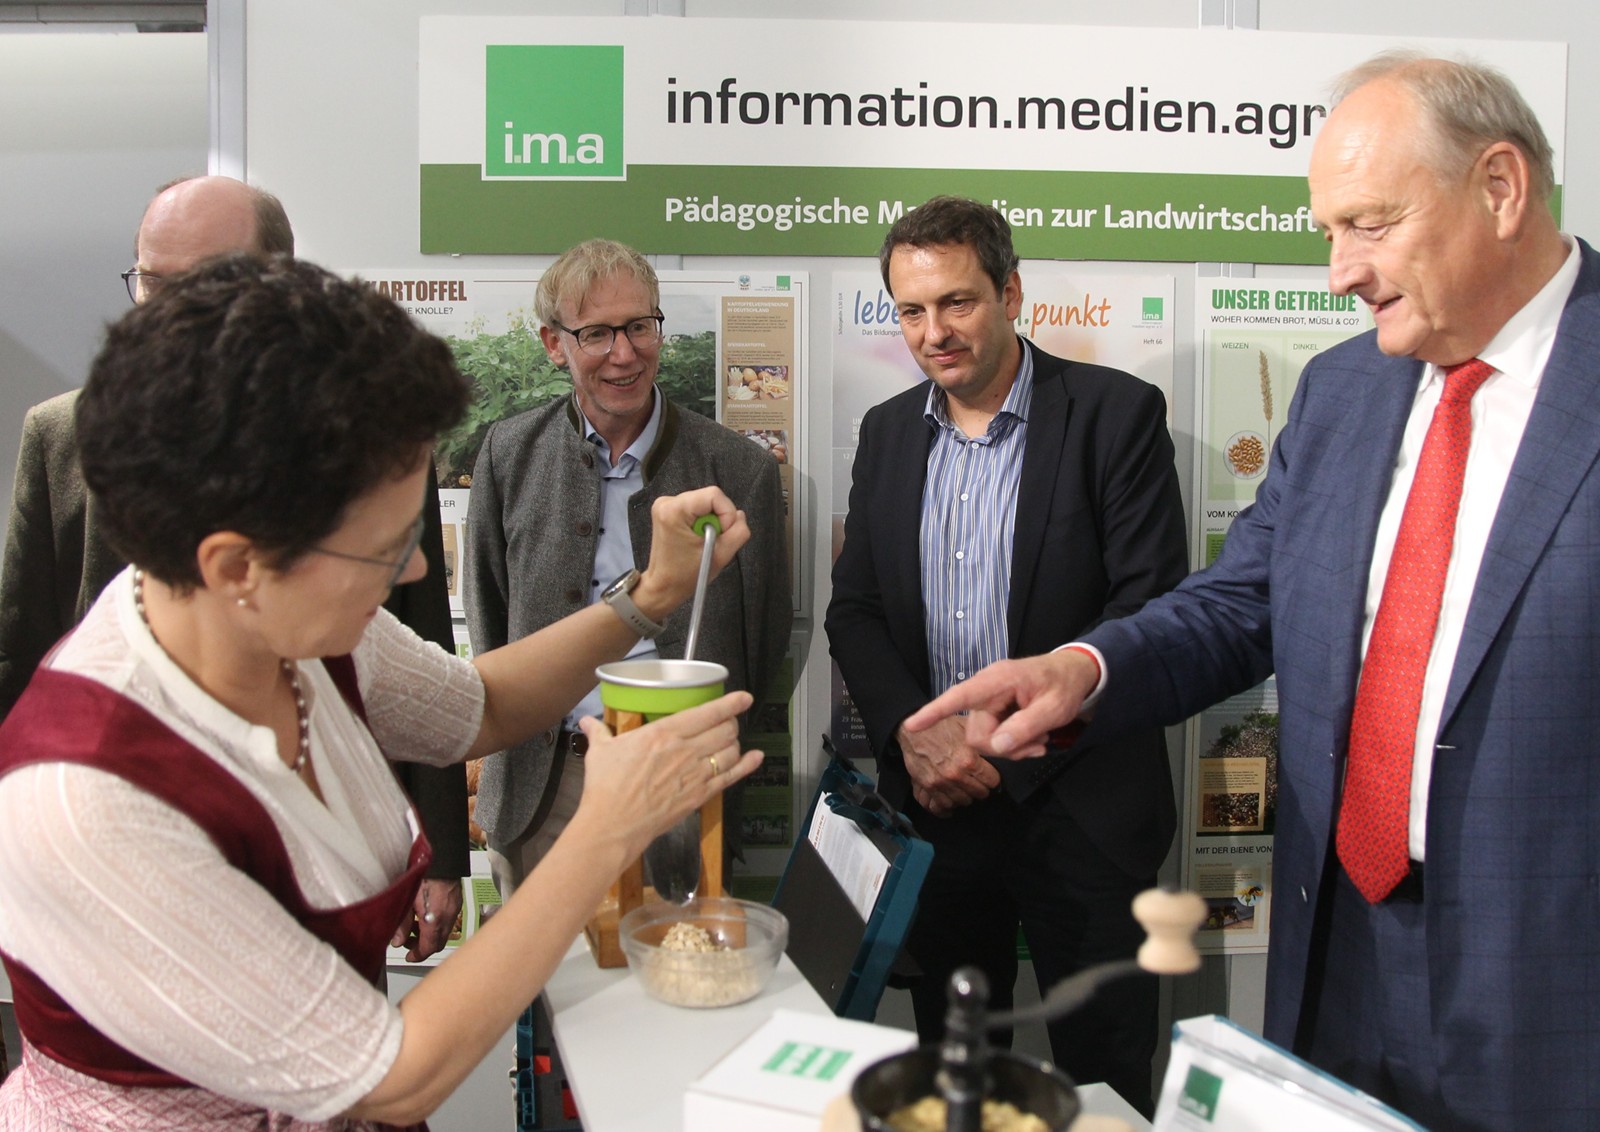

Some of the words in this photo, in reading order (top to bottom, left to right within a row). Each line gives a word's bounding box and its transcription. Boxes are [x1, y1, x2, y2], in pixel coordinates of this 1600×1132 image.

[667, 77, 1327, 149] information.medien.agr
[505, 121, 604, 164] i.m.a
[665, 196, 869, 232] Pädagogische
[1051, 207, 1097, 229] zur
[1104, 203, 1319, 233] Landwirtschaft
[1211, 289, 1270, 311] UNSER
[1274, 290, 1357, 312] GETREIDE
[415, 307, 454, 315] KNOLLE?
[854, 288, 900, 325] lebe
[1211, 316, 1242, 324] WOHER
[1244, 316, 1281, 324] KOMMEN
[1283, 316, 1307, 326] BROT,
[1309, 315, 1333, 325] MÜSLI
[1343, 318, 1359, 326] CO?
[1221, 342, 1249, 350] WEIZEN
[1293, 343, 1319, 351] DINKEL
[1206, 510, 1226, 518] VOM
[1195, 847, 1210, 855] MIT
[1211, 847, 1229, 855] DER
[1230, 846, 1254, 854] BIENE
[1255, 845, 1272, 853] VON
